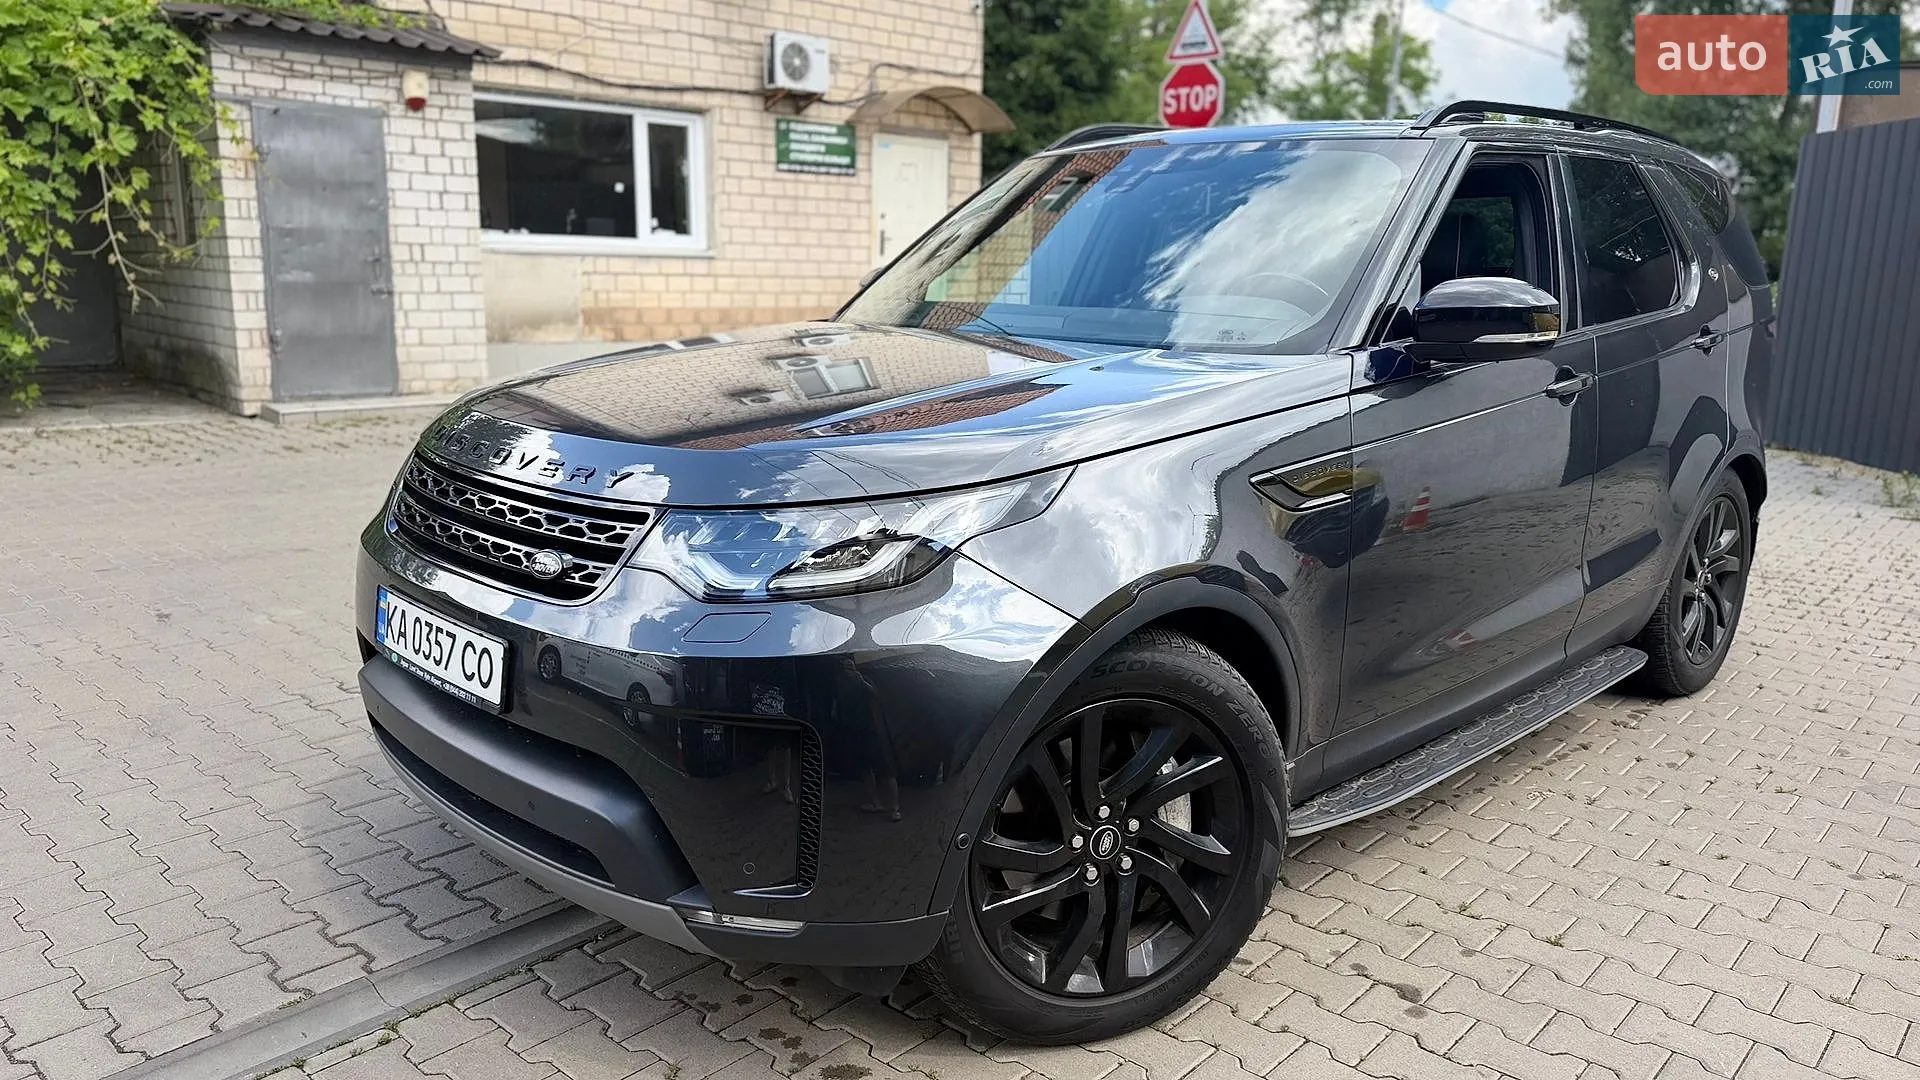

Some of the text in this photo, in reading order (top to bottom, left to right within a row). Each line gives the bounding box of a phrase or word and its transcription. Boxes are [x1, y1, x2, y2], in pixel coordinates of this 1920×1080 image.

[1163, 84, 1218, 115] STOP
[385, 601, 408, 650] KA
[412, 616, 457, 671] 0357
[461, 640, 494, 689] CO
[1090, 659, 1225, 697] SCORPION
[1227, 698, 1272, 759] ZERO
